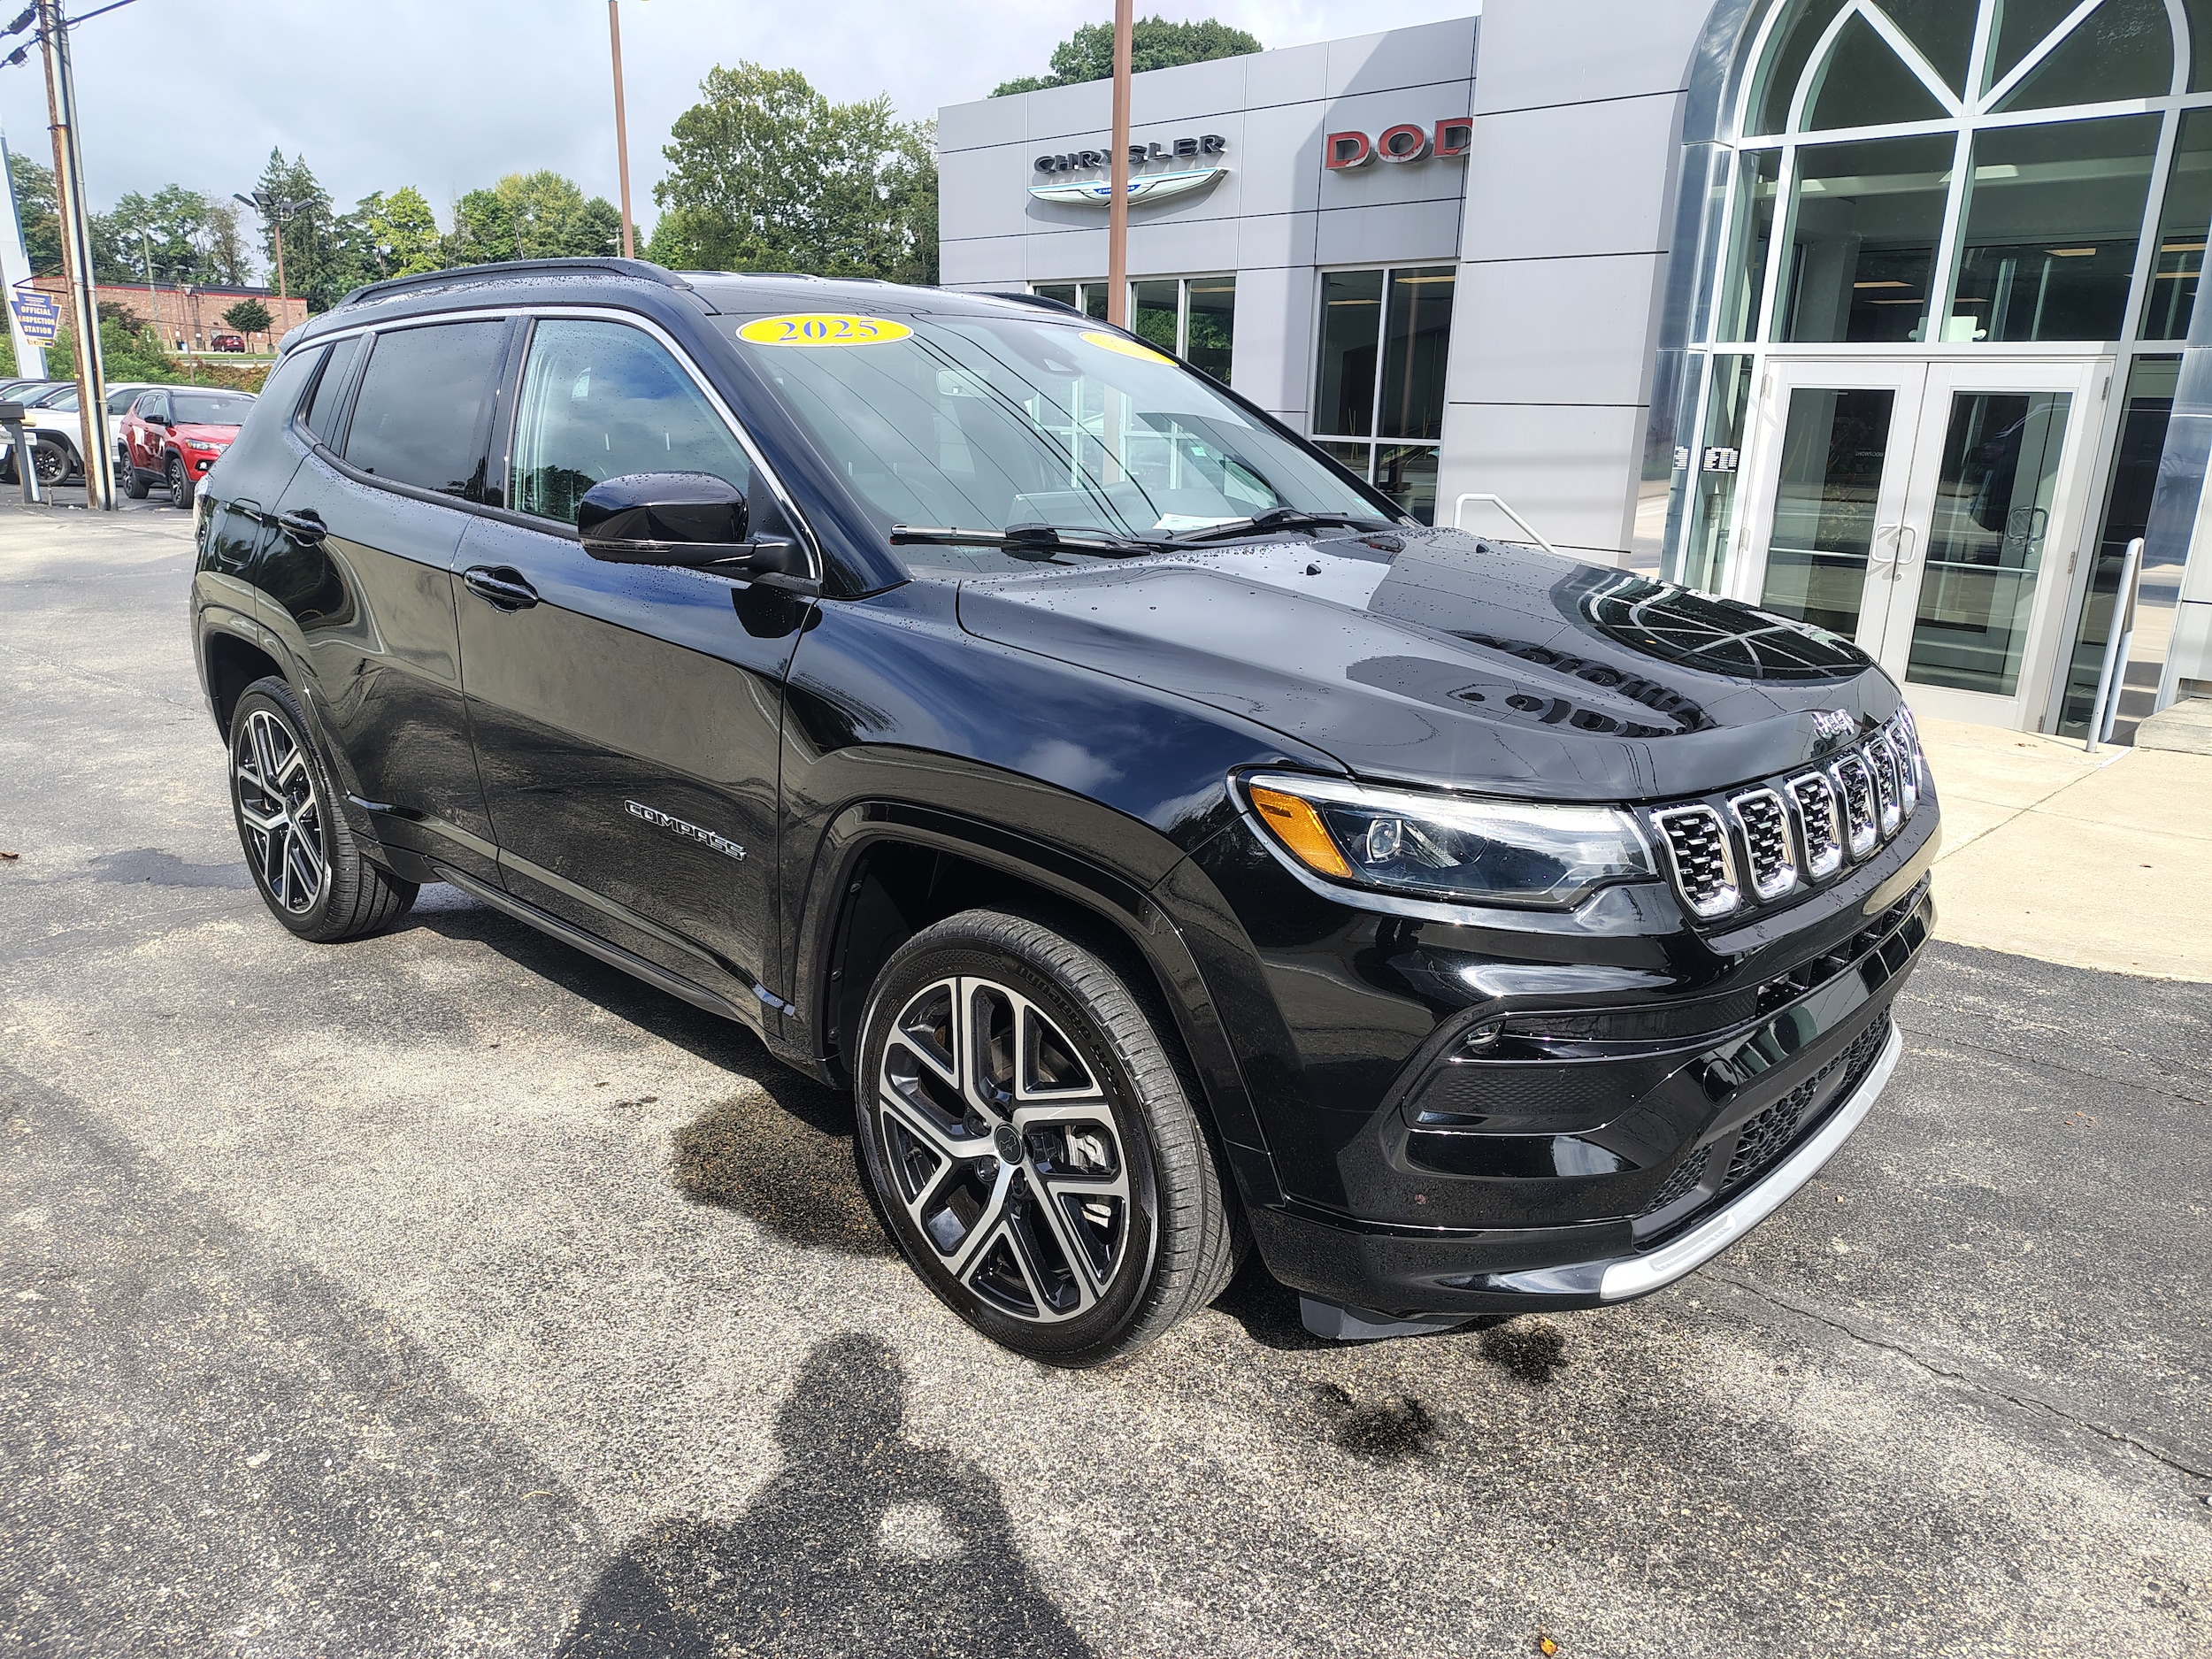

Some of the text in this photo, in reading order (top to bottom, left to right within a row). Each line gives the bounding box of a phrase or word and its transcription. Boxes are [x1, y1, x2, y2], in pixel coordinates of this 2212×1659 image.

[20, 305, 52, 316] OFFICIAL
[18, 315, 56, 326] INSPECTION
[23, 325, 52, 334] STATION
[774, 319, 879, 342] 2025
[1810, 709, 1855, 740] Jeep
[624, 799, 746, 862] COMPASS
